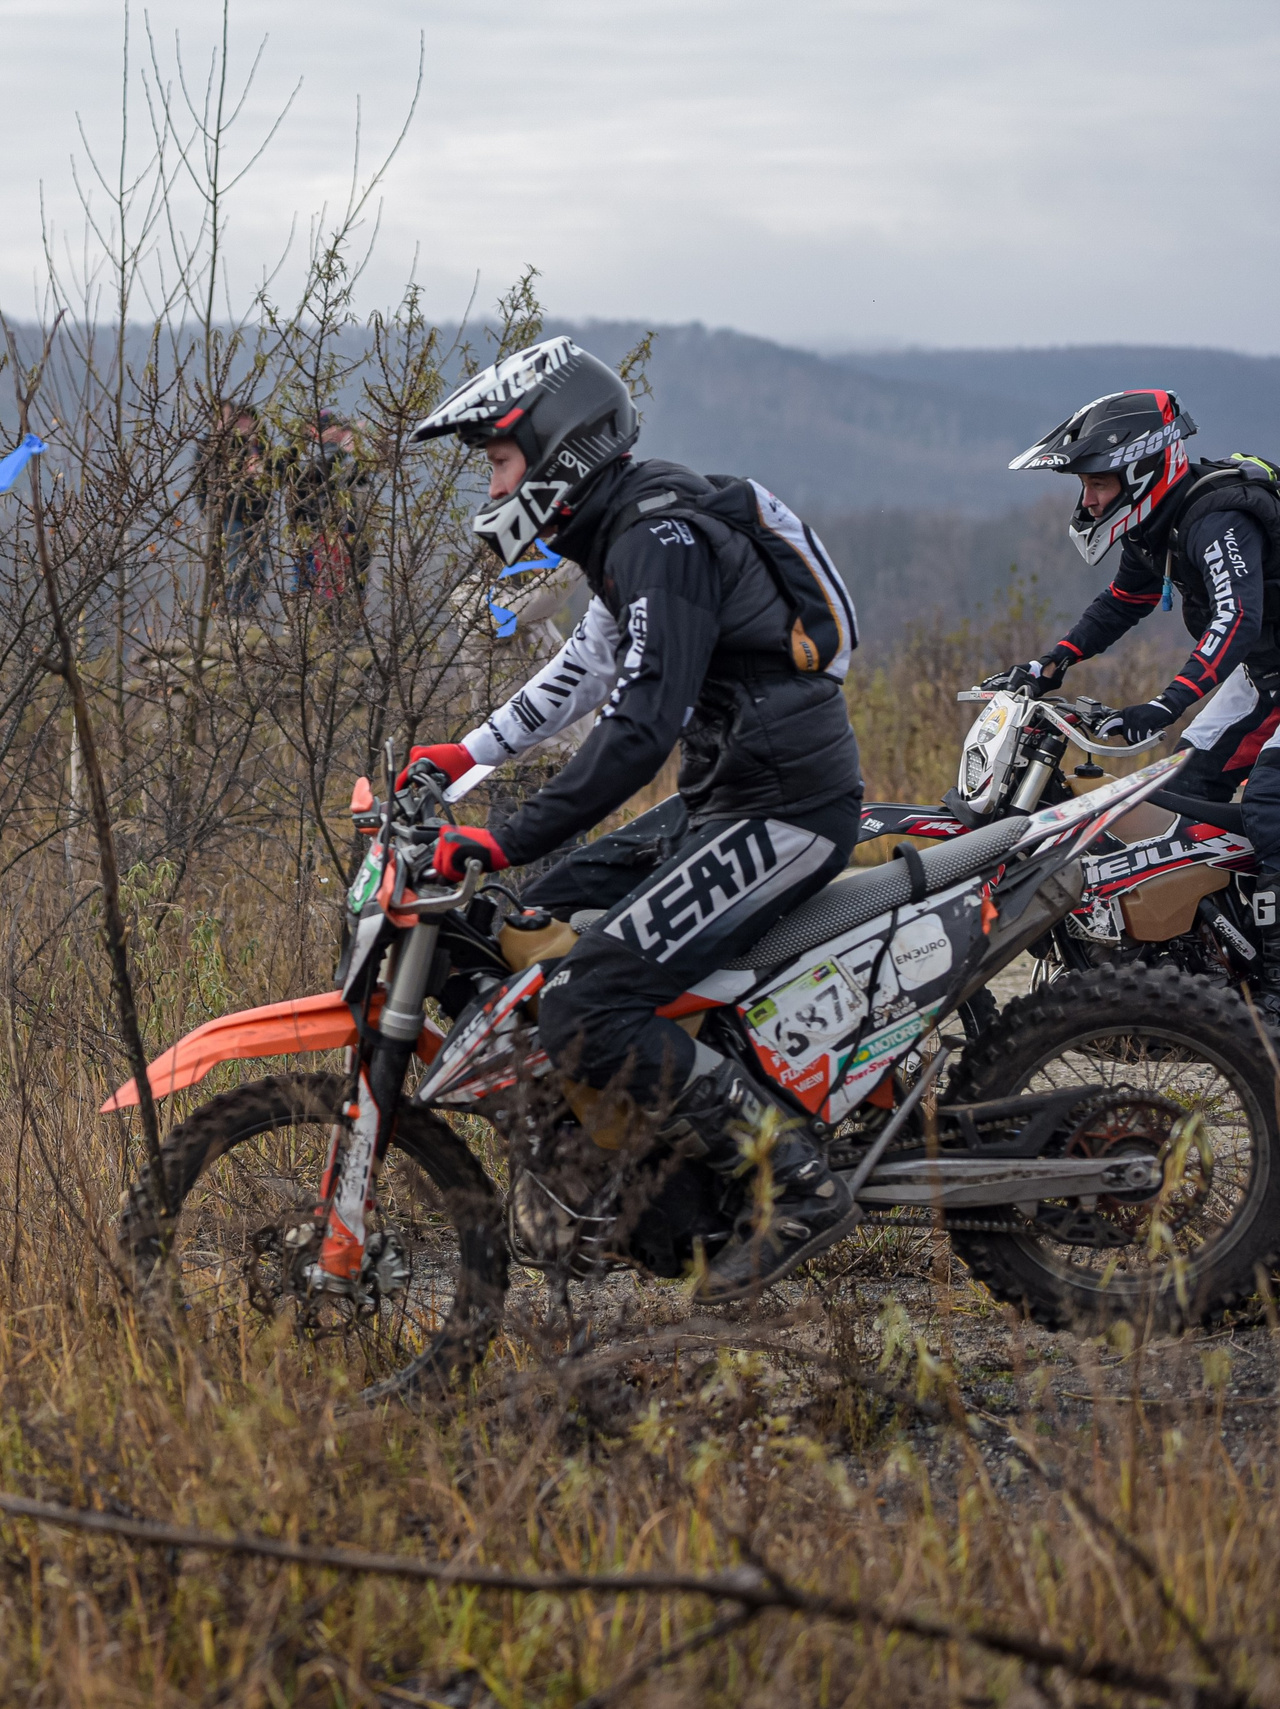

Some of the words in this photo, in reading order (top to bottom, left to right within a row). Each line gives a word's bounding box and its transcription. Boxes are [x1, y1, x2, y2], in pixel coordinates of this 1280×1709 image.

[1024, 454, 1064, 468] Airoh
[1109, 421, 1181, 468] 100%
[619, 818, 777, 956] LEATT
